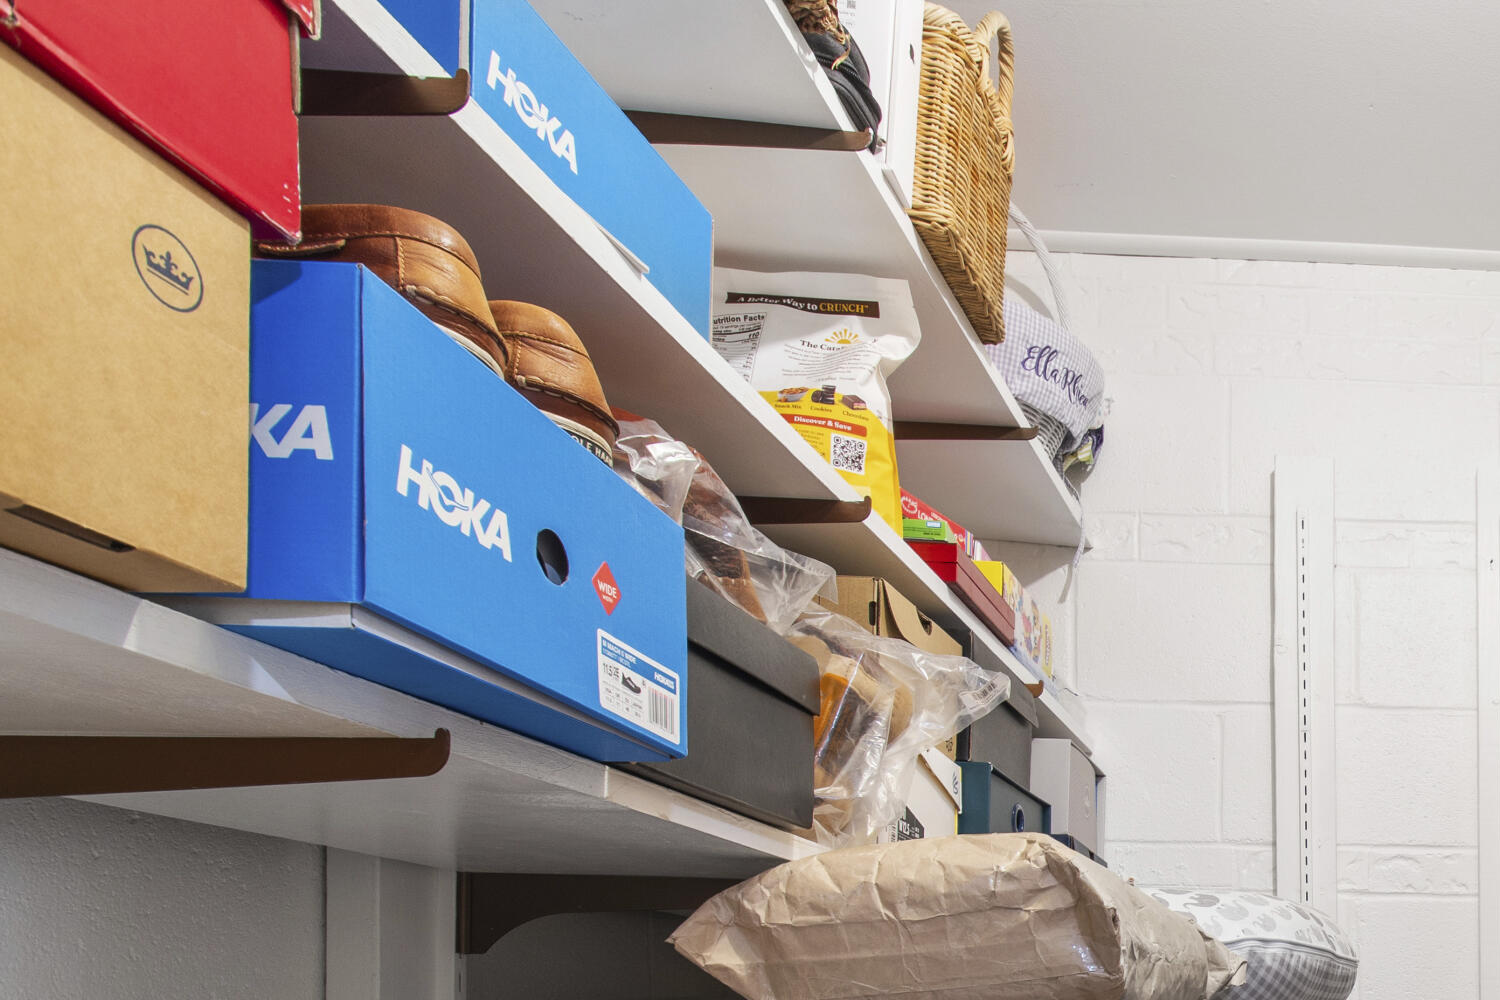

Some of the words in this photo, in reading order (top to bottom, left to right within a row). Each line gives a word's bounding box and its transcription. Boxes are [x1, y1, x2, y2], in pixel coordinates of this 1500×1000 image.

[486, 49, 578, 175] HOKA
[807, 302, 818, 311] to
[819, 302, 864, 314] CRUNCH
[713, 315, 742, 325] utrition
[743, 314, 765, 323] Facts
[800, 340, 818, 349] The
[1021, 345, 1060, 384] Ella
[249, 403, 334, 460] KA
[793, 416, 826, 425] Discover
[826, 419, 834, 427] &
[834, 421, 852, 431] Save
[396, 444, 512, 562] HOKA
[597, 579, 617, 599] WIDE
